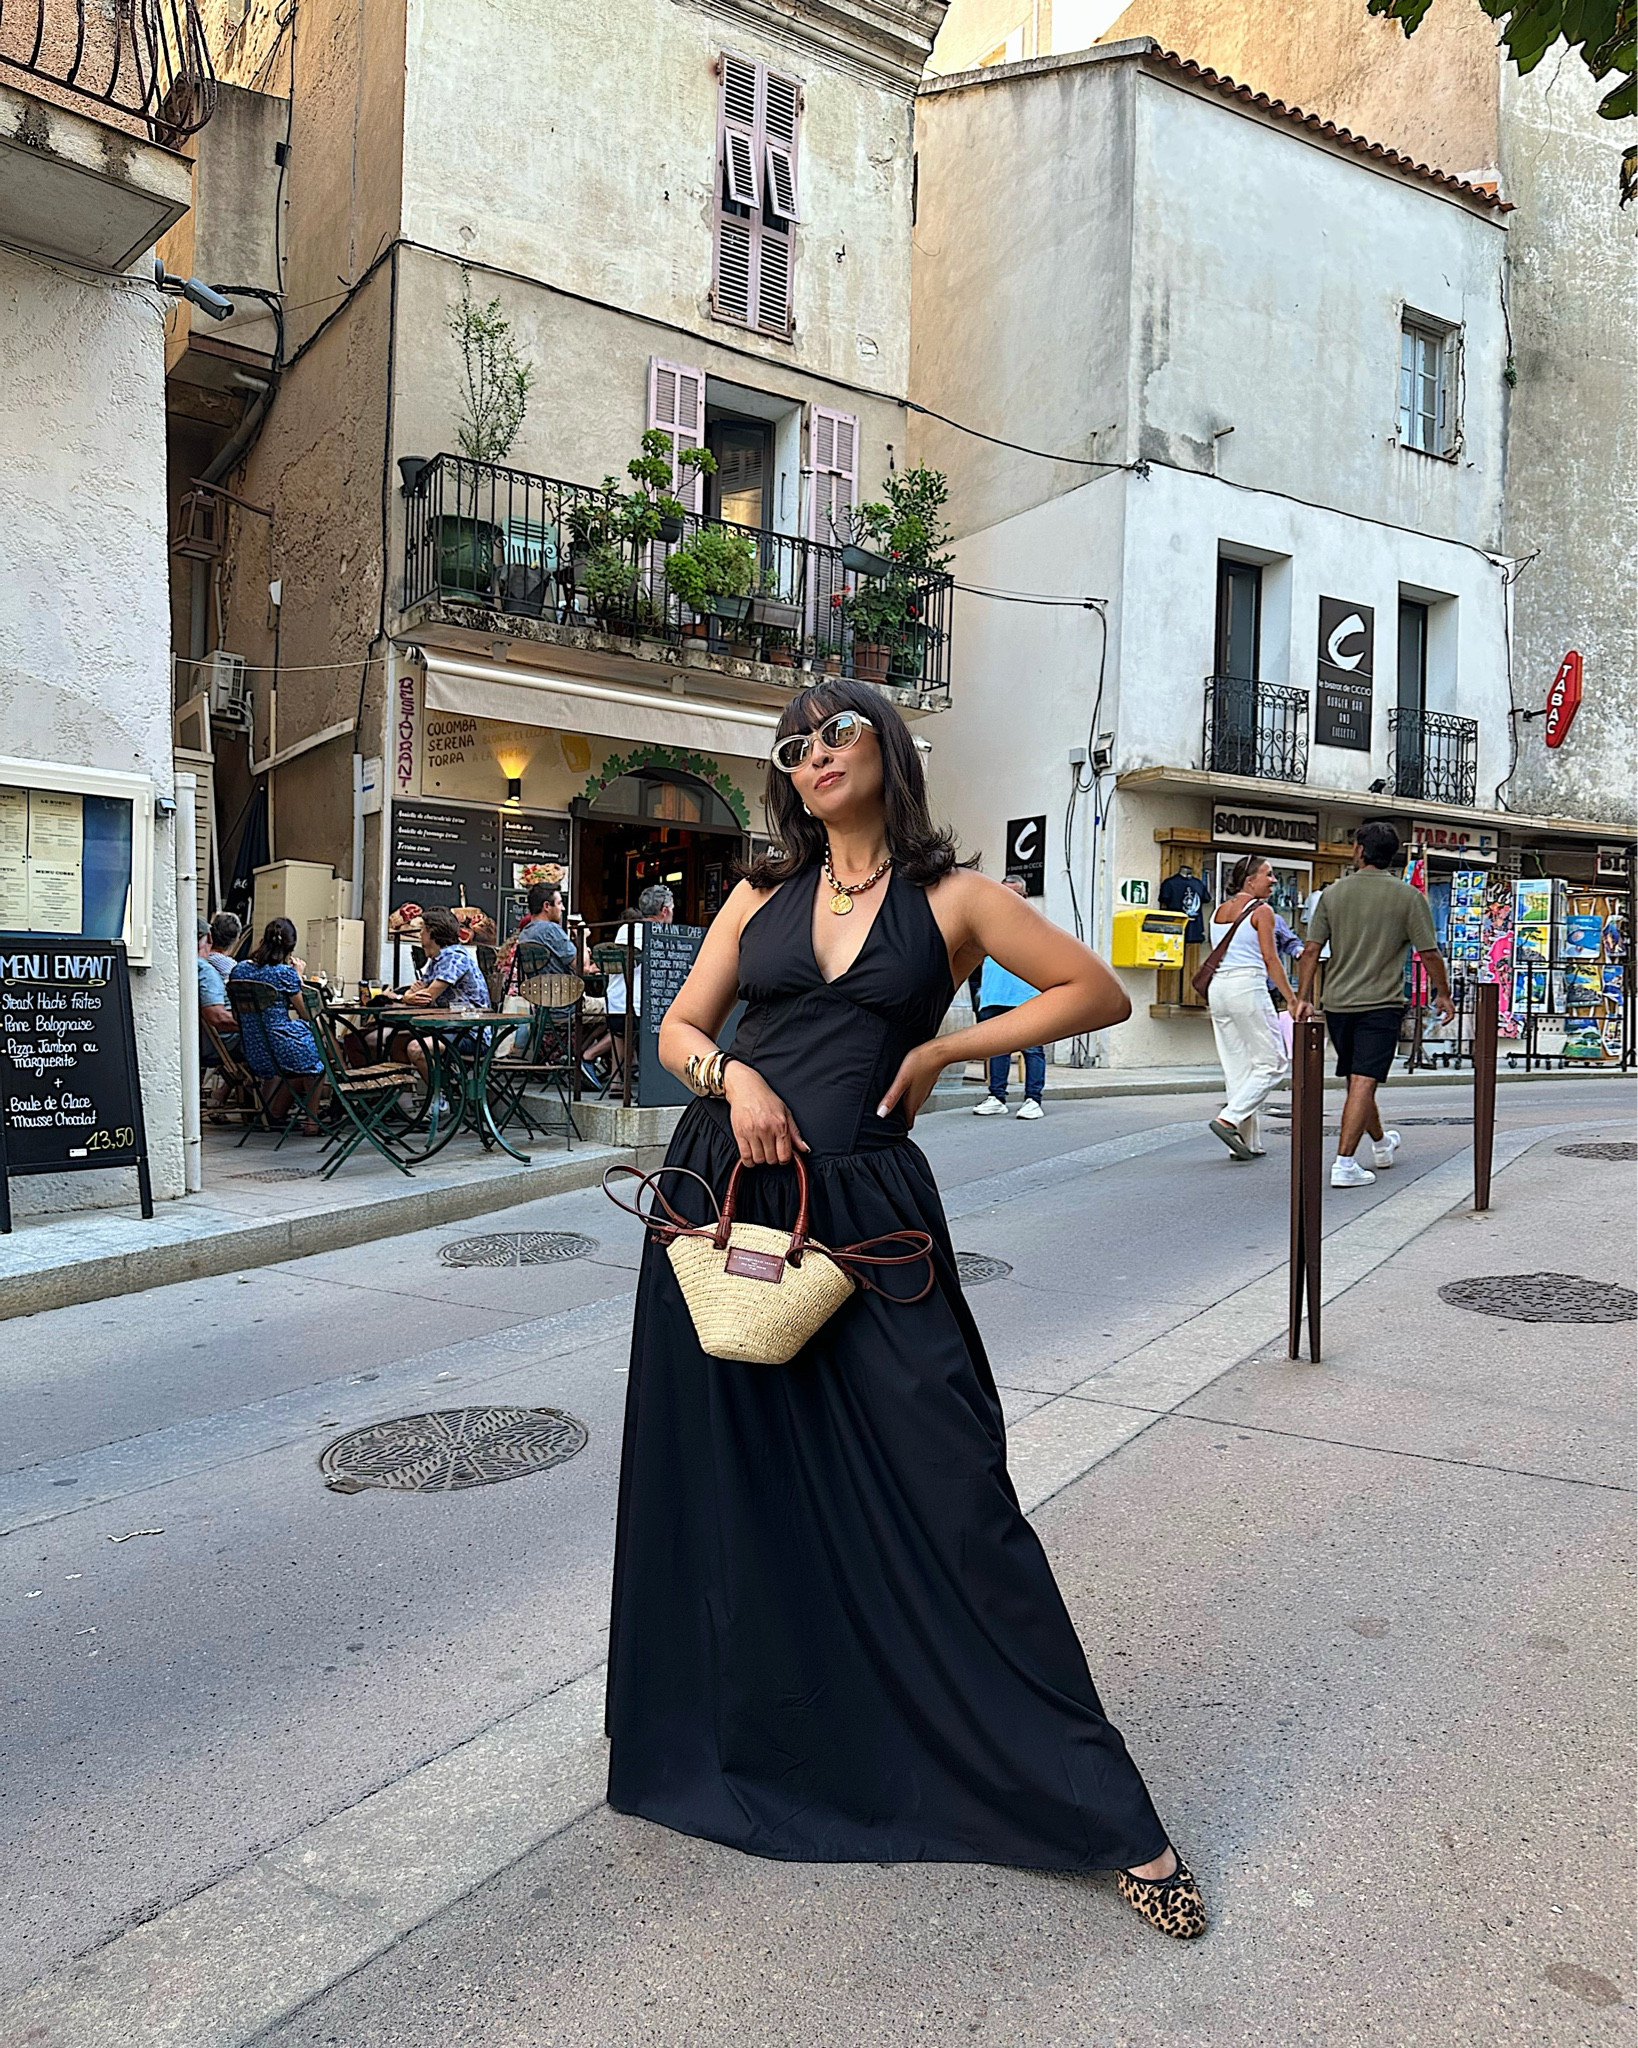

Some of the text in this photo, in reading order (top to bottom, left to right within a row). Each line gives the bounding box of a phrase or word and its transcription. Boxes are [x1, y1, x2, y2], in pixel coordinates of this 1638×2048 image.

[1351, 685, 1371, 696] CICCIO
[1547, 664, 1572, 734] TABAC
[427, 719, 477, 736] COLOMBA
[427, 734, 475, 752] SERENA
[428, 752, 465, 767] TORRA
[1414, 826, 1470, 847] TABAC
[0, 955, 117, 980] MENU ENFANT
[4, 1014, 95, 1038] Penne Bolognaise
[7, 1038, 99, 1058] Pizza Jambon ou
[10, 1093, 92, 1112] Boule de Glace
[54, 1110, 97, 1126] Chocolat
[85, 1127, 134, 1151] 13,50
